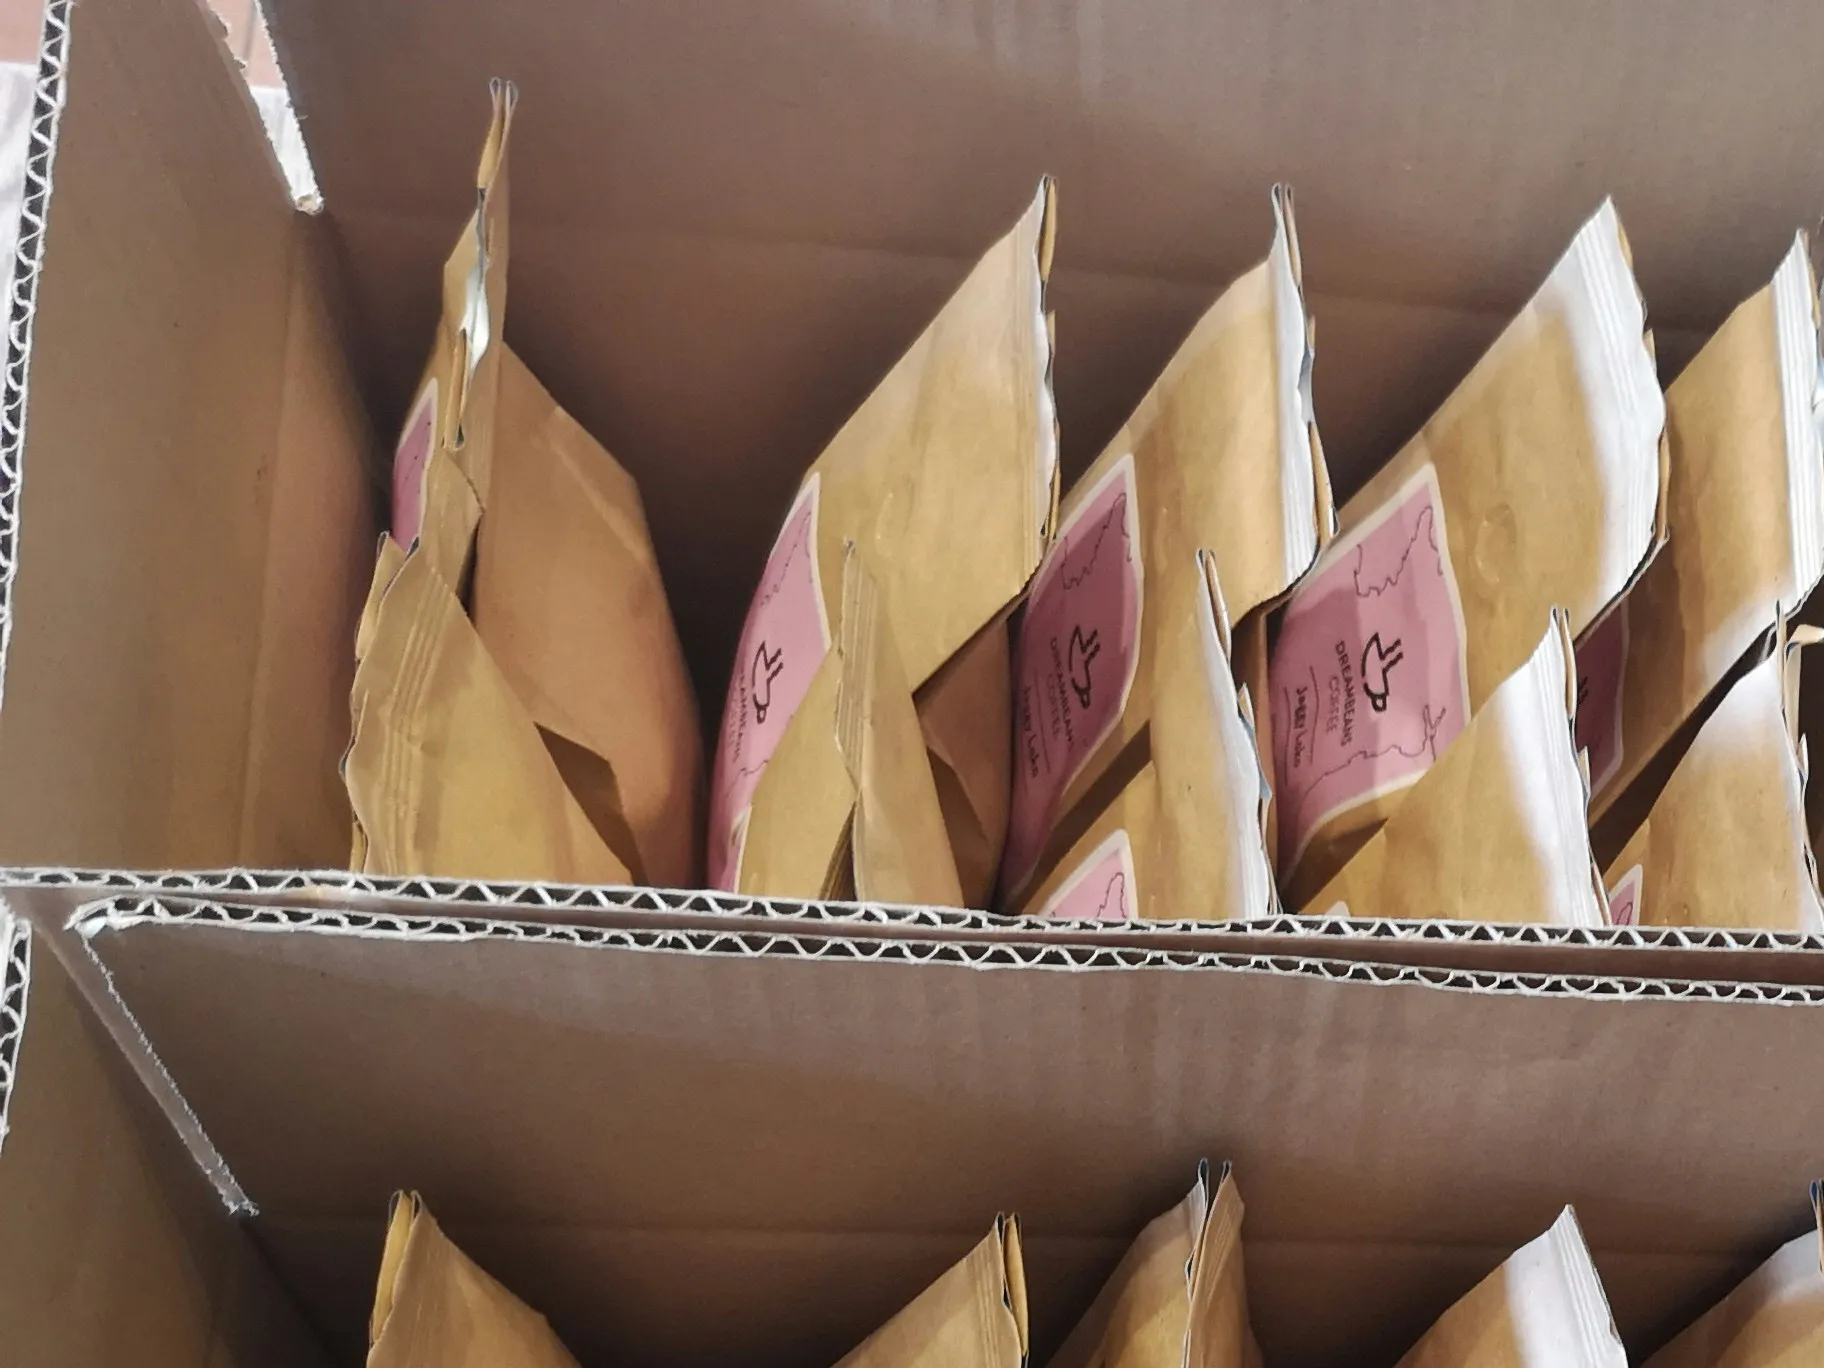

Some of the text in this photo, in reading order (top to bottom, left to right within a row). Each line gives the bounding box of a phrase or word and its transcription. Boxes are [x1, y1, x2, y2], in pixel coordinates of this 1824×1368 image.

[1050, 636, 1076, 752] DREAMBEANS
[1325, 675, 1341, 734] COFFEE
[1335, 639, 1356, 748] DREAMBEANS
